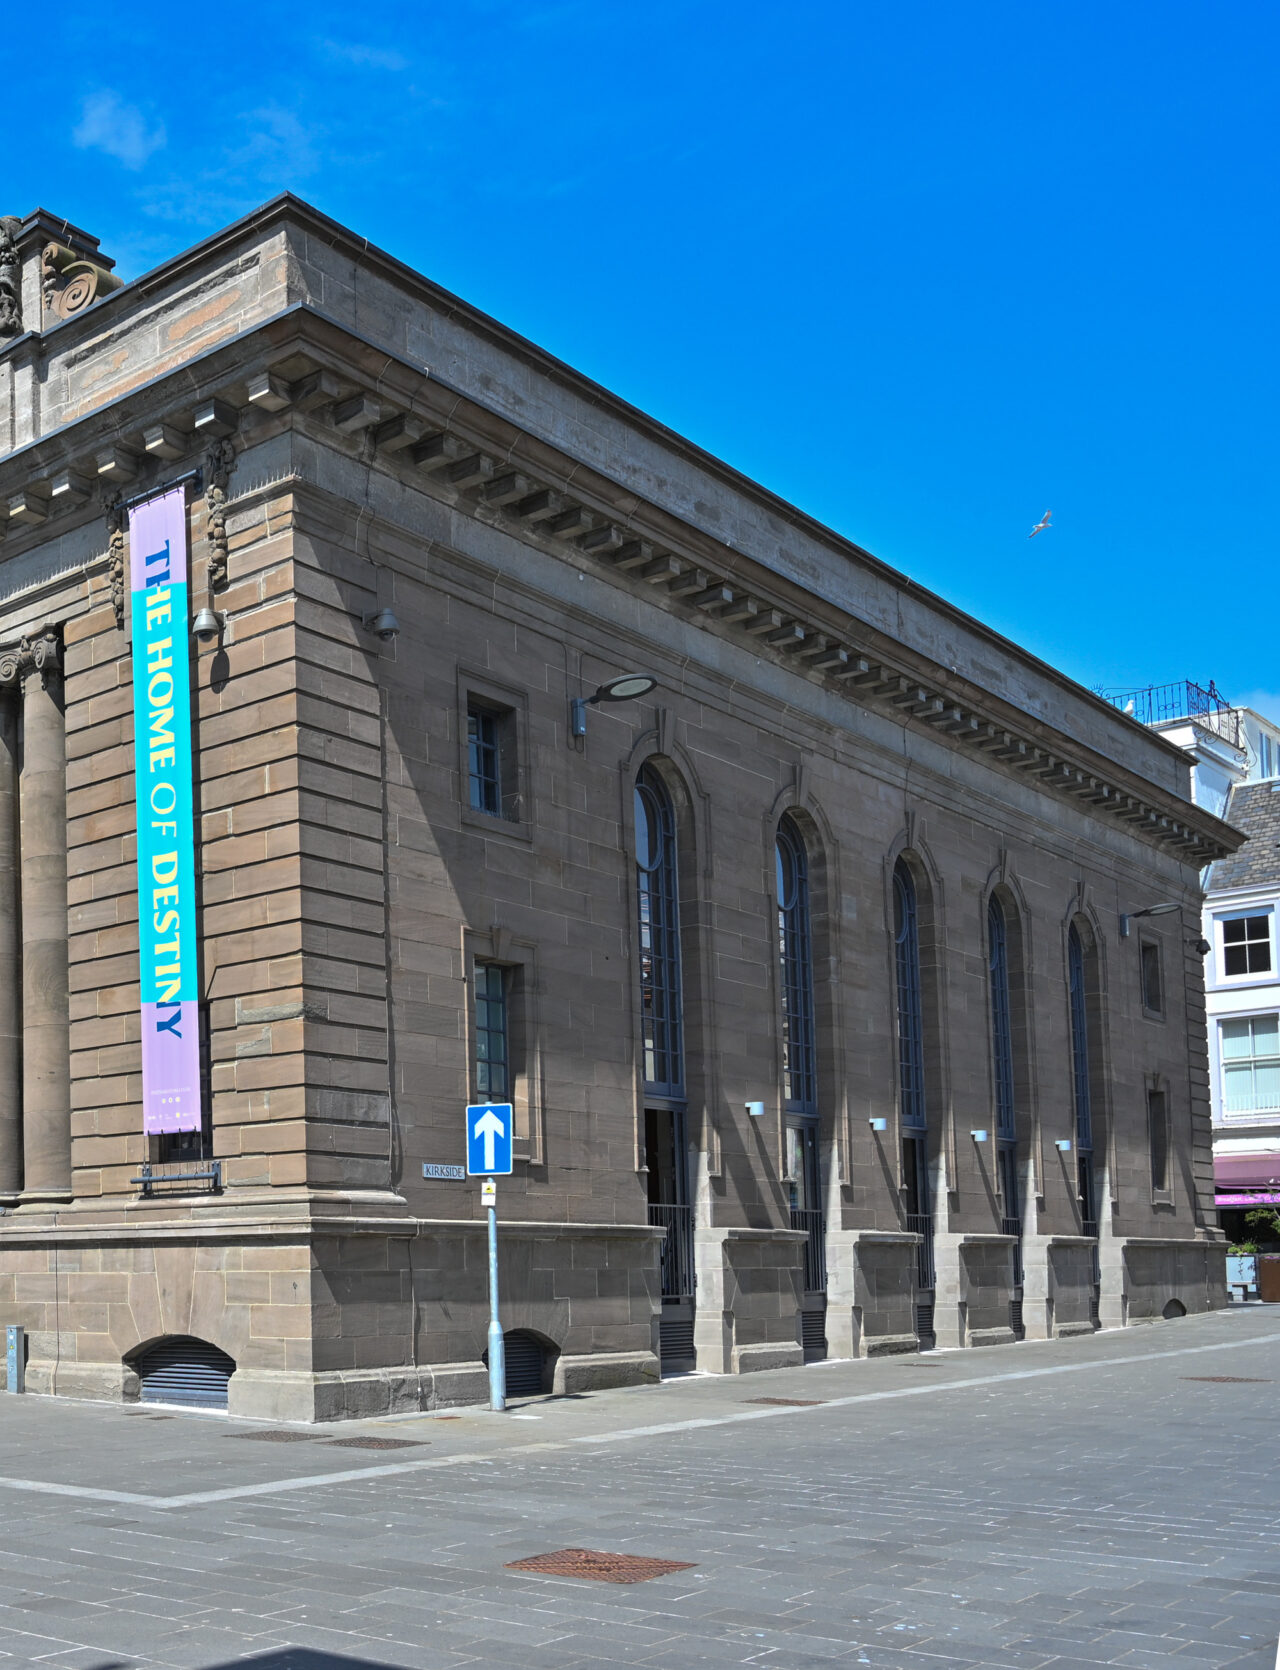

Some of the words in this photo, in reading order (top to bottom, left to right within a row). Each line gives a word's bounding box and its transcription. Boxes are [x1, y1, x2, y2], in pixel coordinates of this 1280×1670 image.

[145, 539, 172, 631] THE
[147, 636, 175, 773] HOME
[150, 782, 177, 838] OF
[152, 850, 182, 1039] DESTINY
[425, 1165, 463, 1178] KIRKSIDE
